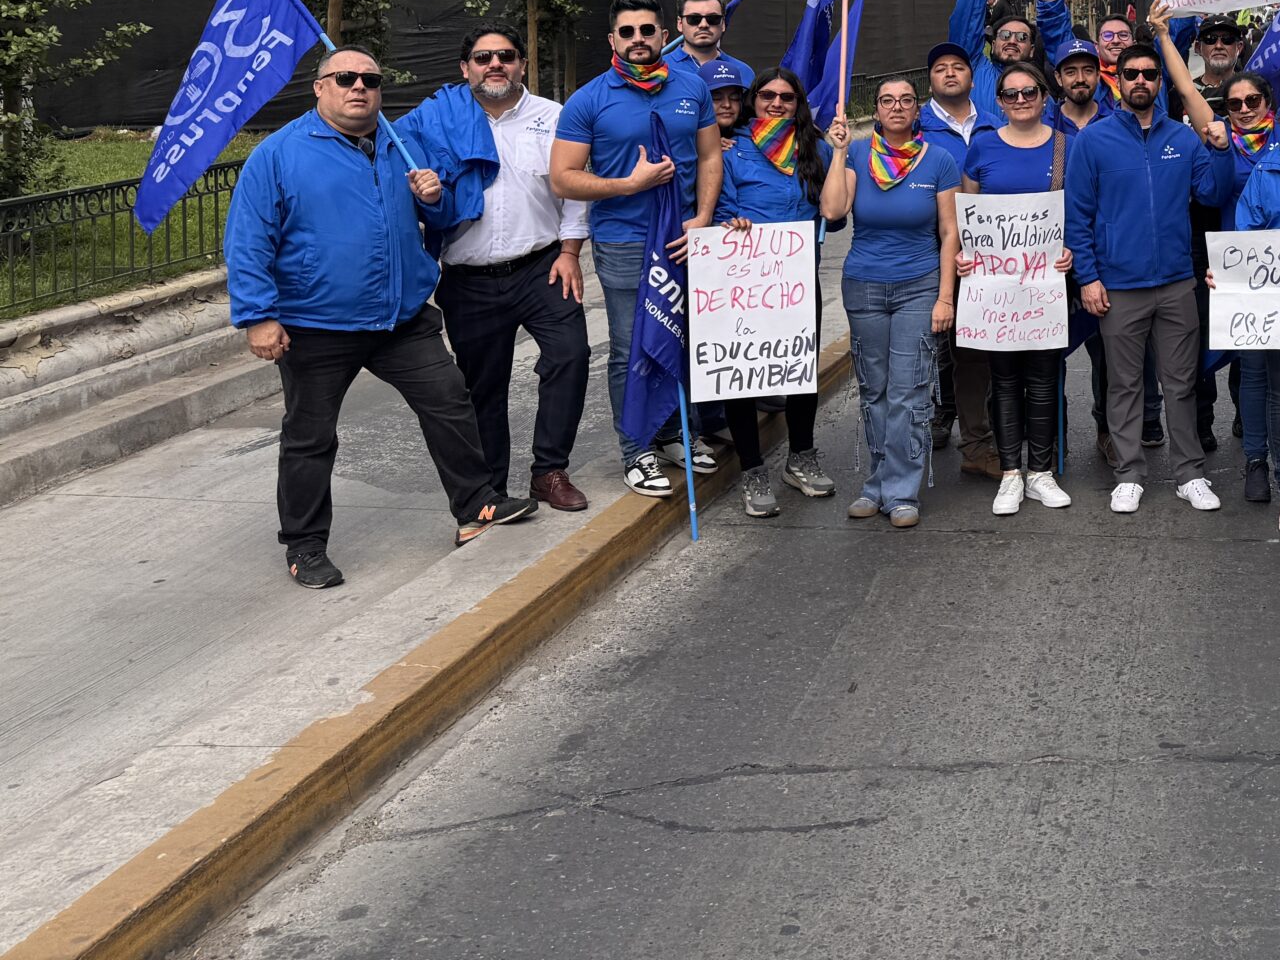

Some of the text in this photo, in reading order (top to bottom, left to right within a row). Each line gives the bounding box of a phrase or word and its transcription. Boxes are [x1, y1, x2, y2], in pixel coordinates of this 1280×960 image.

[964, 205, 1049, 230] Fenpruss
[717, 227, 804, 260] SALUD
[962, 223, 1063, 250] Area Valdivia
[726, 263, 751, 279] es
[972, 251, 1047, 285] APOYA
[693, 281, 805, 315] DERECHO
[966, 286, 984, 302] Ni
[982, 306, 1044, 324] menos
[735, 317, 756, 337] la
[1234, 333, 1271, 347] CON
